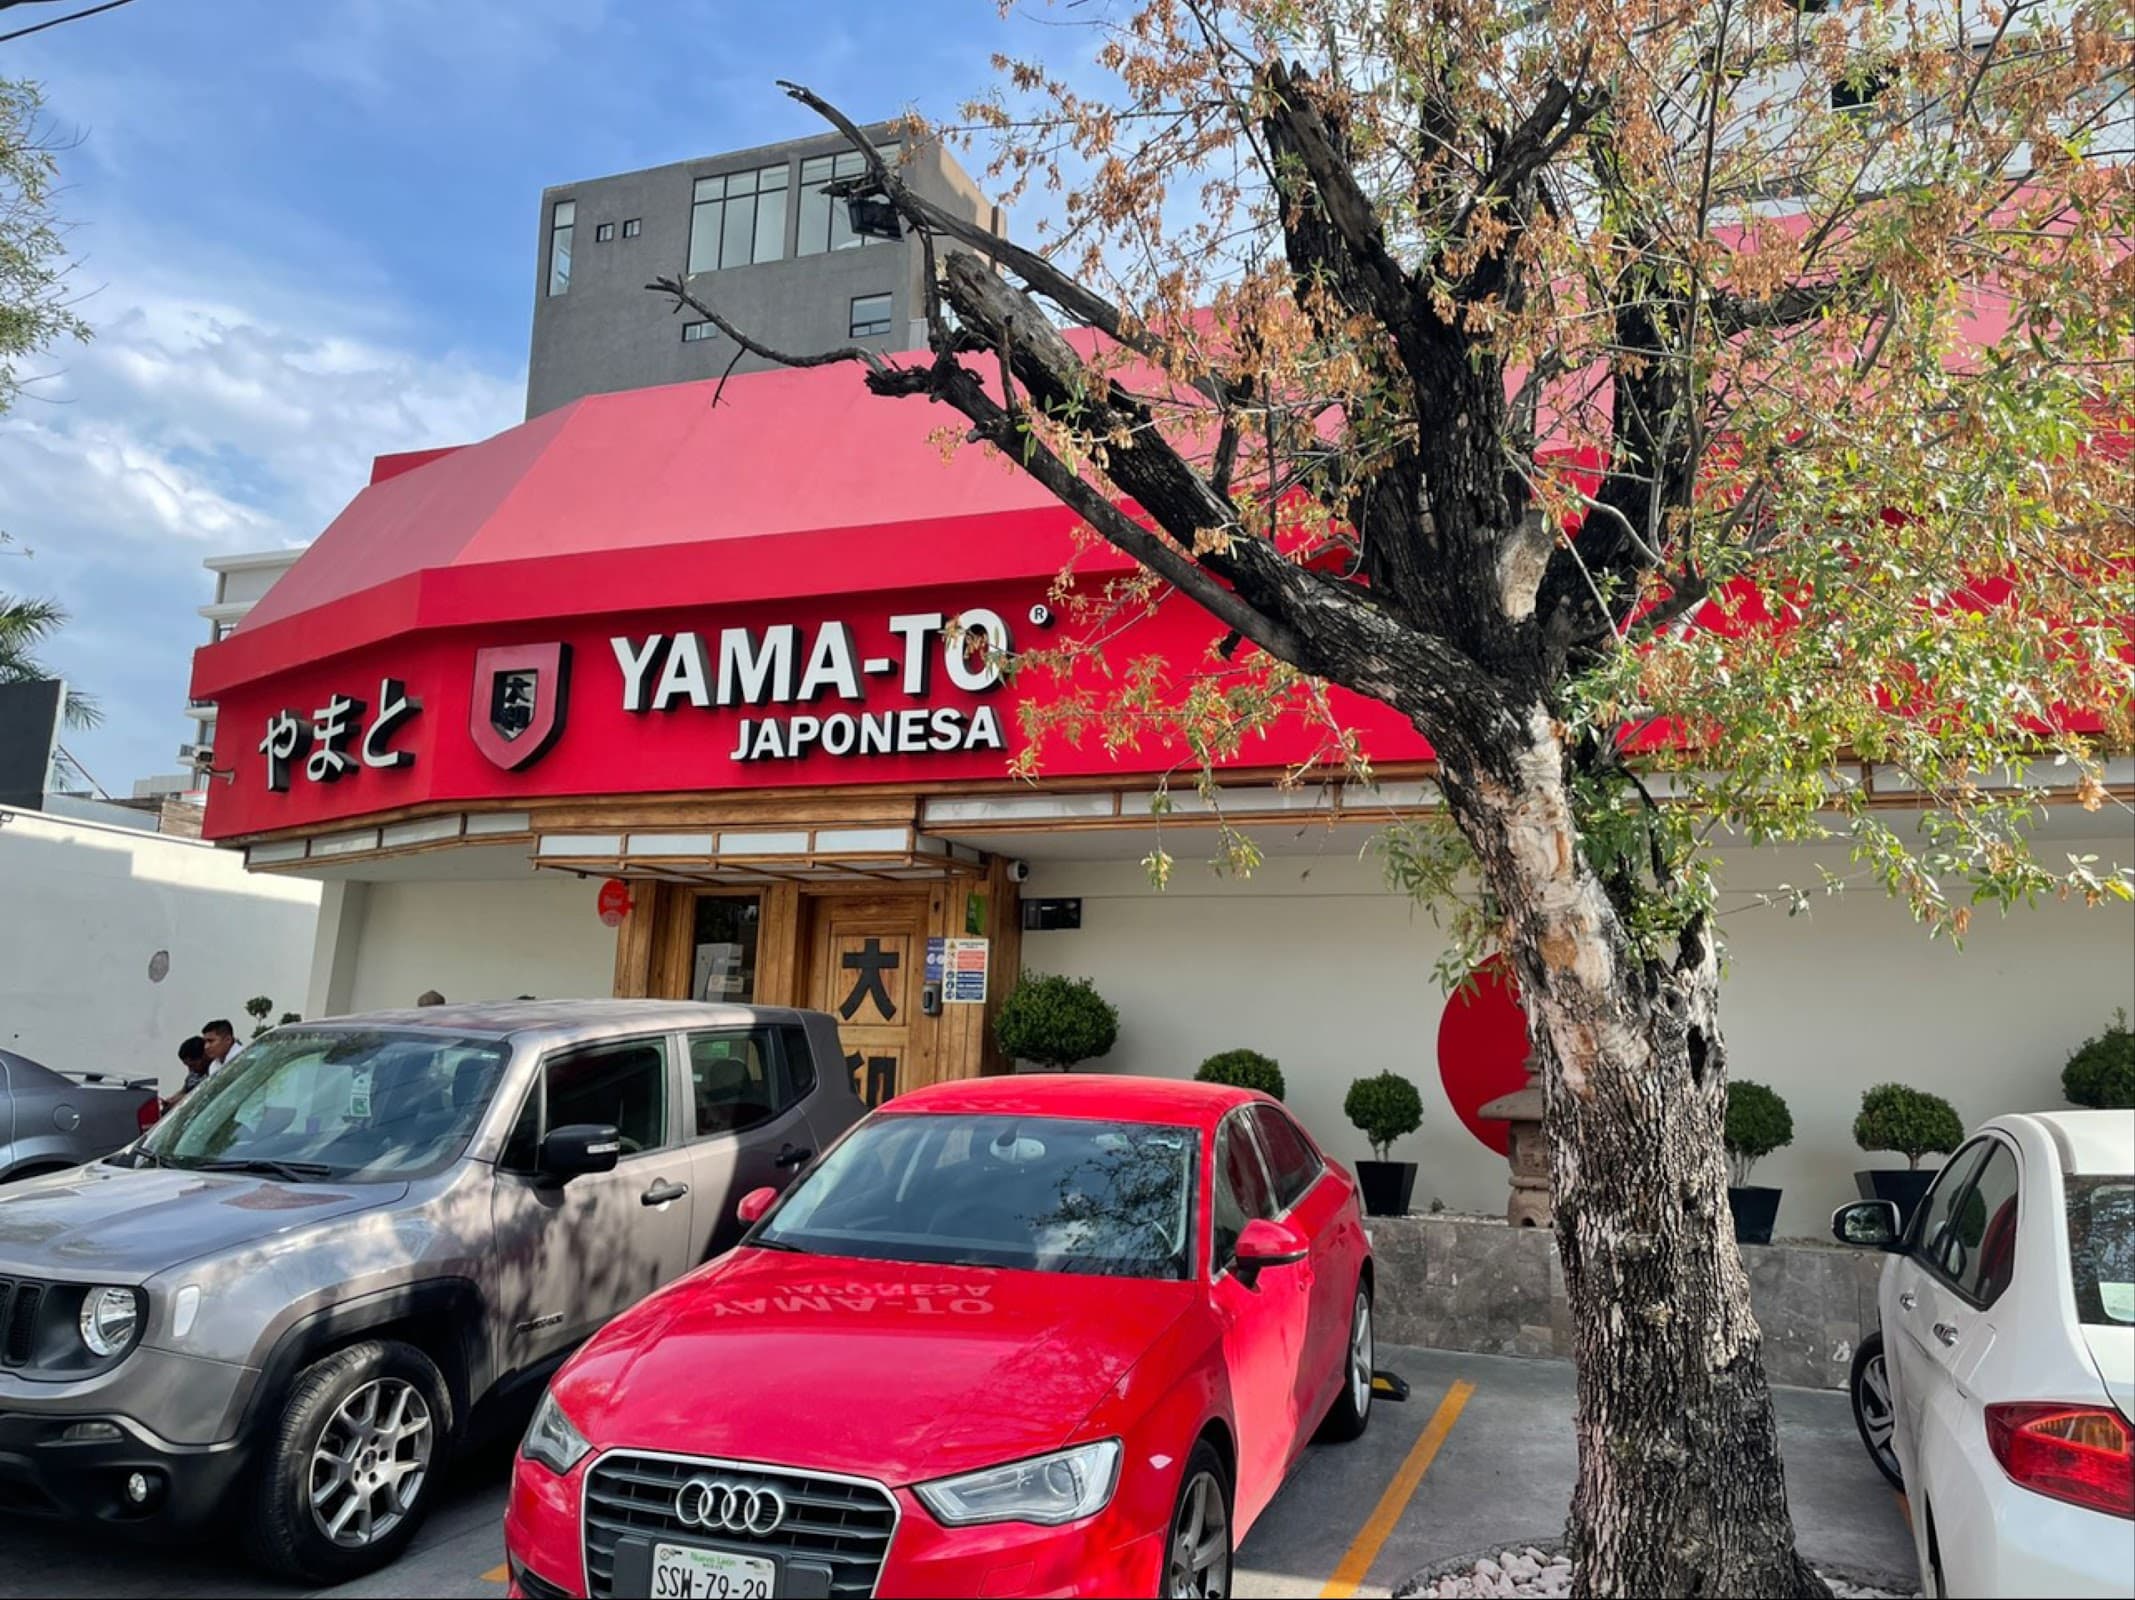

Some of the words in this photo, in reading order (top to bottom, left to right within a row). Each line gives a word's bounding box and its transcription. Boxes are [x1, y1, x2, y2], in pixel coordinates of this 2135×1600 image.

[609, 608, 1010, 711] YAMA-TO
[258, 678, 410, 791] やまと
[730, 705, 1003, 761] JAPONESA
